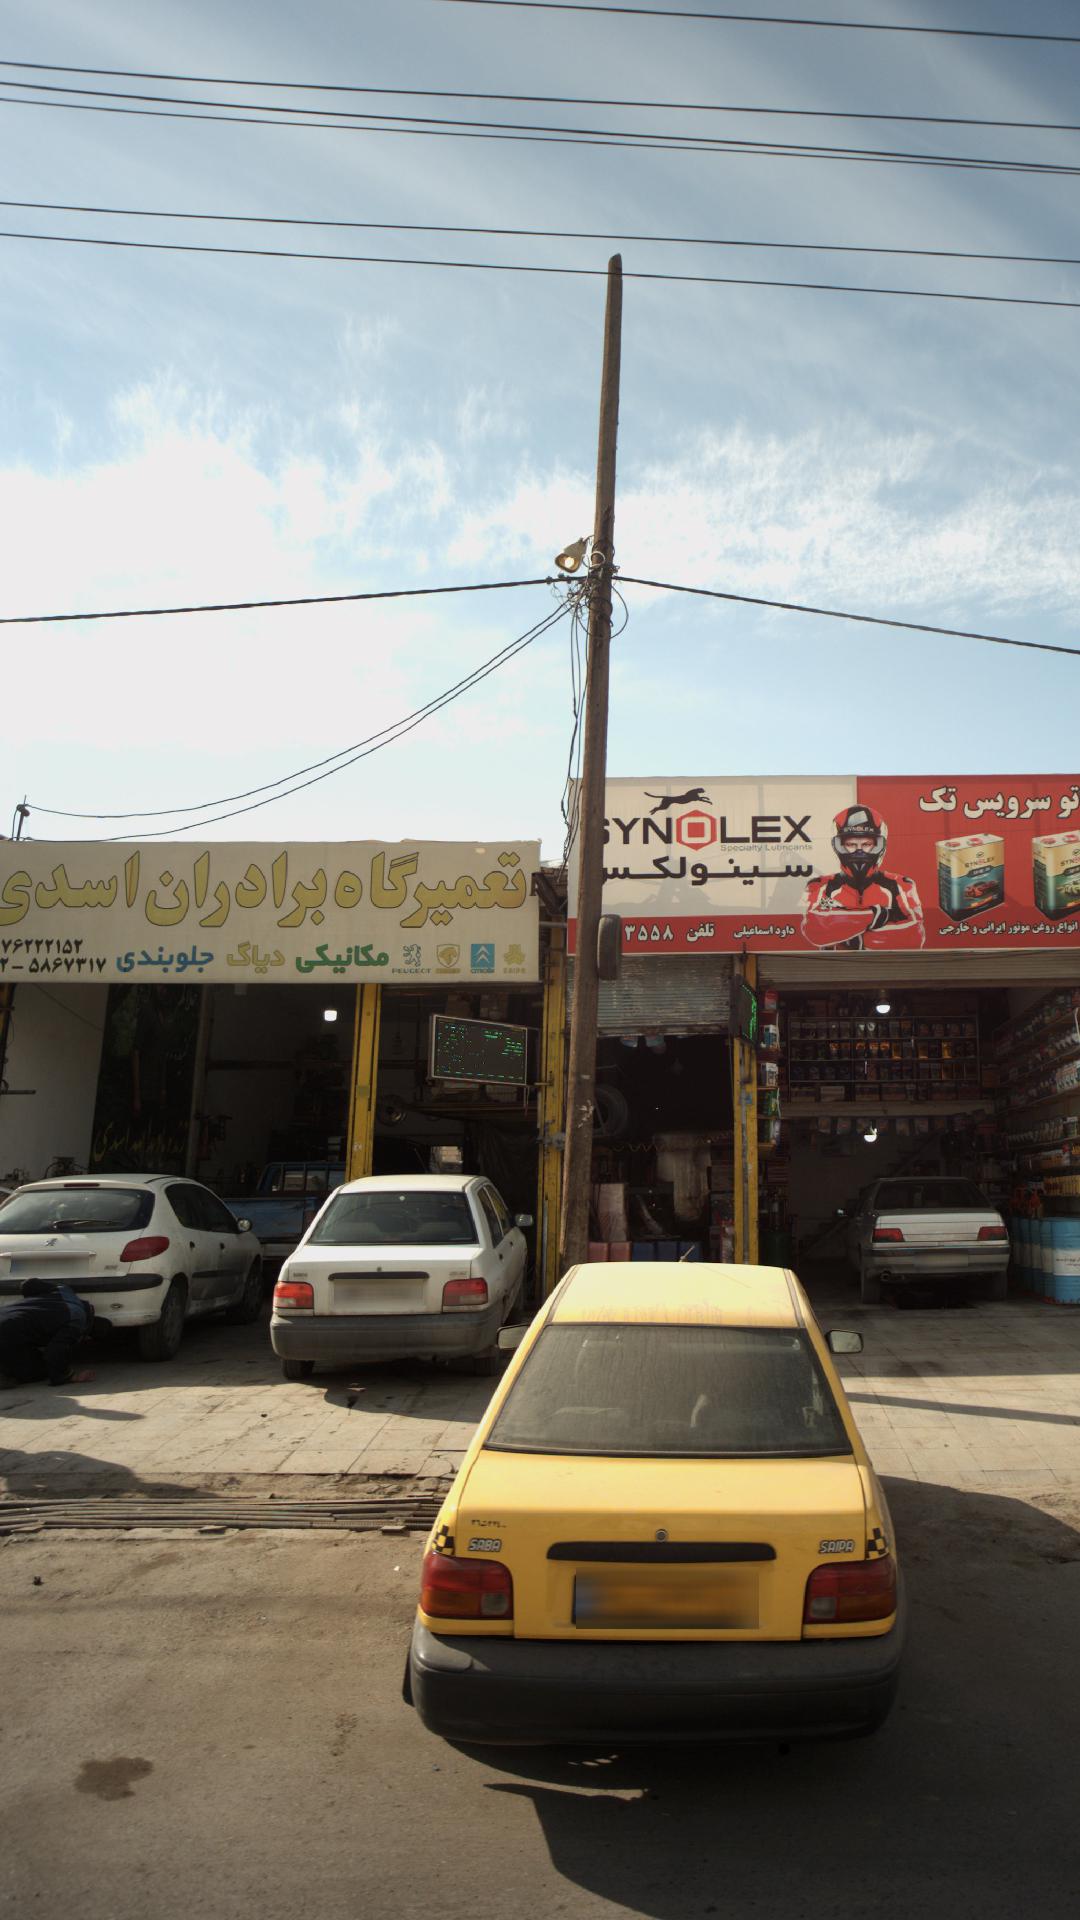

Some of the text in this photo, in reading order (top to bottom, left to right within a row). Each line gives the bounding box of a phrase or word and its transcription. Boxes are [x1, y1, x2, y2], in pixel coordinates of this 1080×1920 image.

[919, 784, 957, 812] تک
[963, 792, 1052, 819] سرویس
[720, 843, 813, 853] Specialty Lubricants
[144, 850, 328, 928] برادران
[336, 850, 527, 928] تعمیرگاه
[686, 922, 715, 943] تلفن
[733, 925, 796, 939] داود اسماعیلی
[939, 921, 970, 936] خارجی
[979, 921, 1006, 935] ایرانی
[1032, 923, 1055, 935] روغن
[1057, 921, 1078, 934] انواع
[116, 944, 215, 973] جلوبندی
[226, 941, 286, 975] دیاگ
[295, 943, 390, 974] مکانیکی
[468, 1538, 501, 1552] SABA
[818, 1538, 855, 1553] SAIPA
